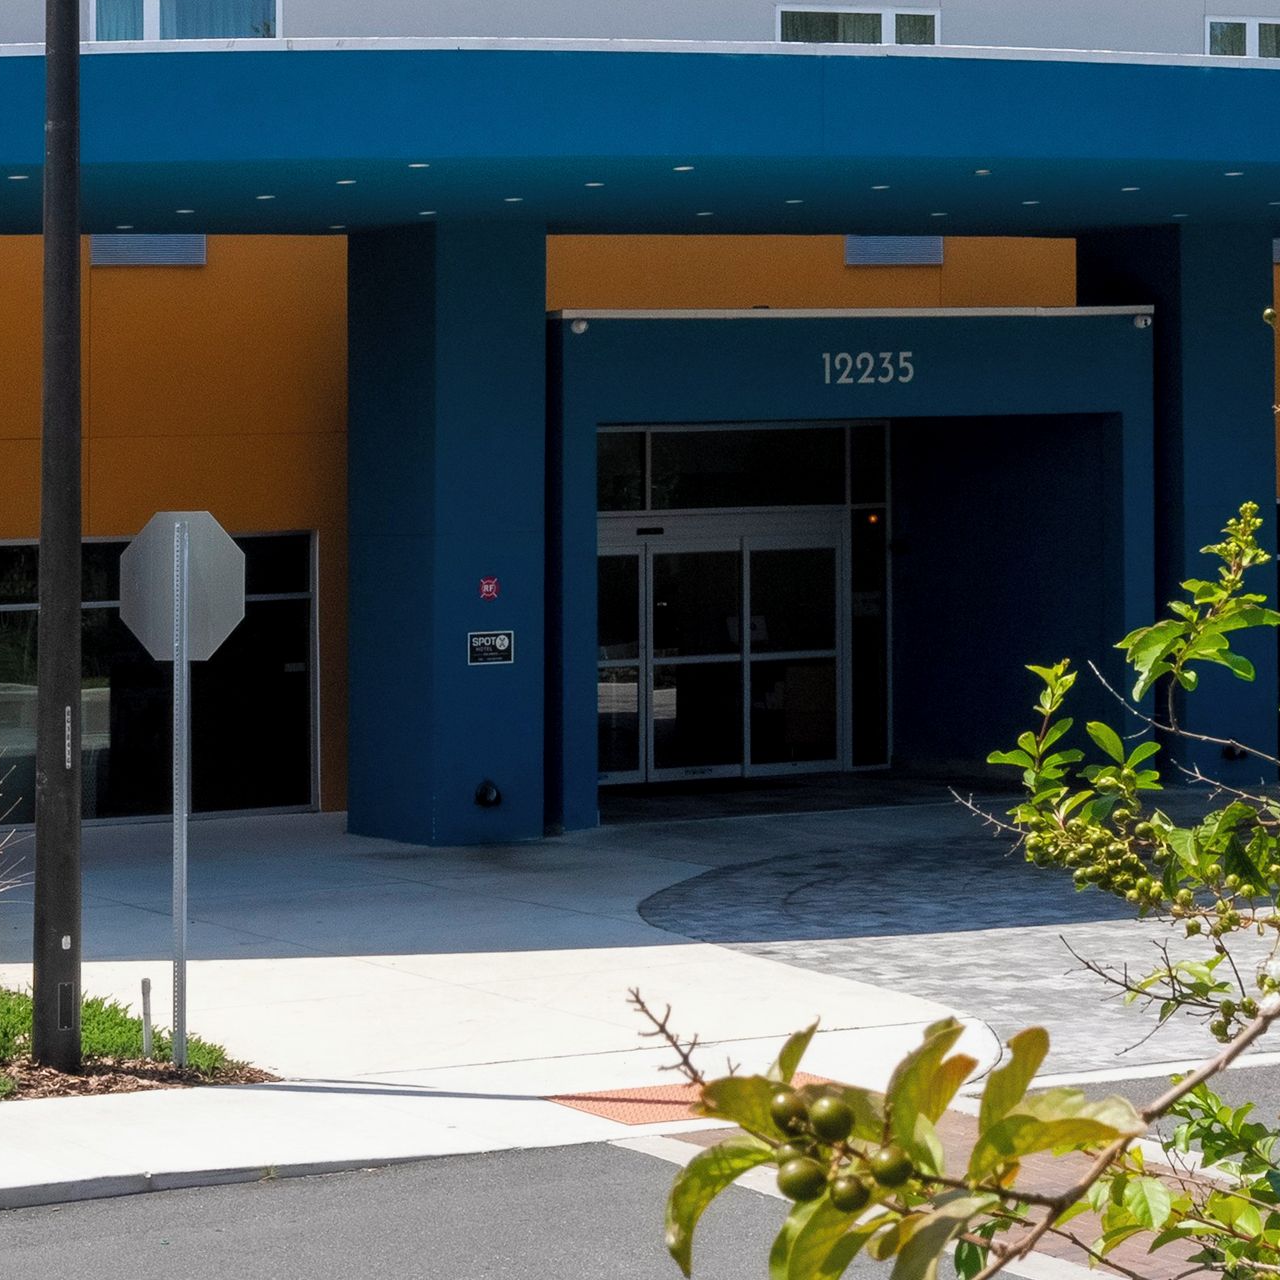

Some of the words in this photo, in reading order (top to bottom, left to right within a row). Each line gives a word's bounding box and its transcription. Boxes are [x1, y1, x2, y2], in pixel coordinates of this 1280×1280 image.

[822, 351, 914, 384] 12235
[483, 584, 494, 592] RF
[472, 636, 496, 646] SPOT
